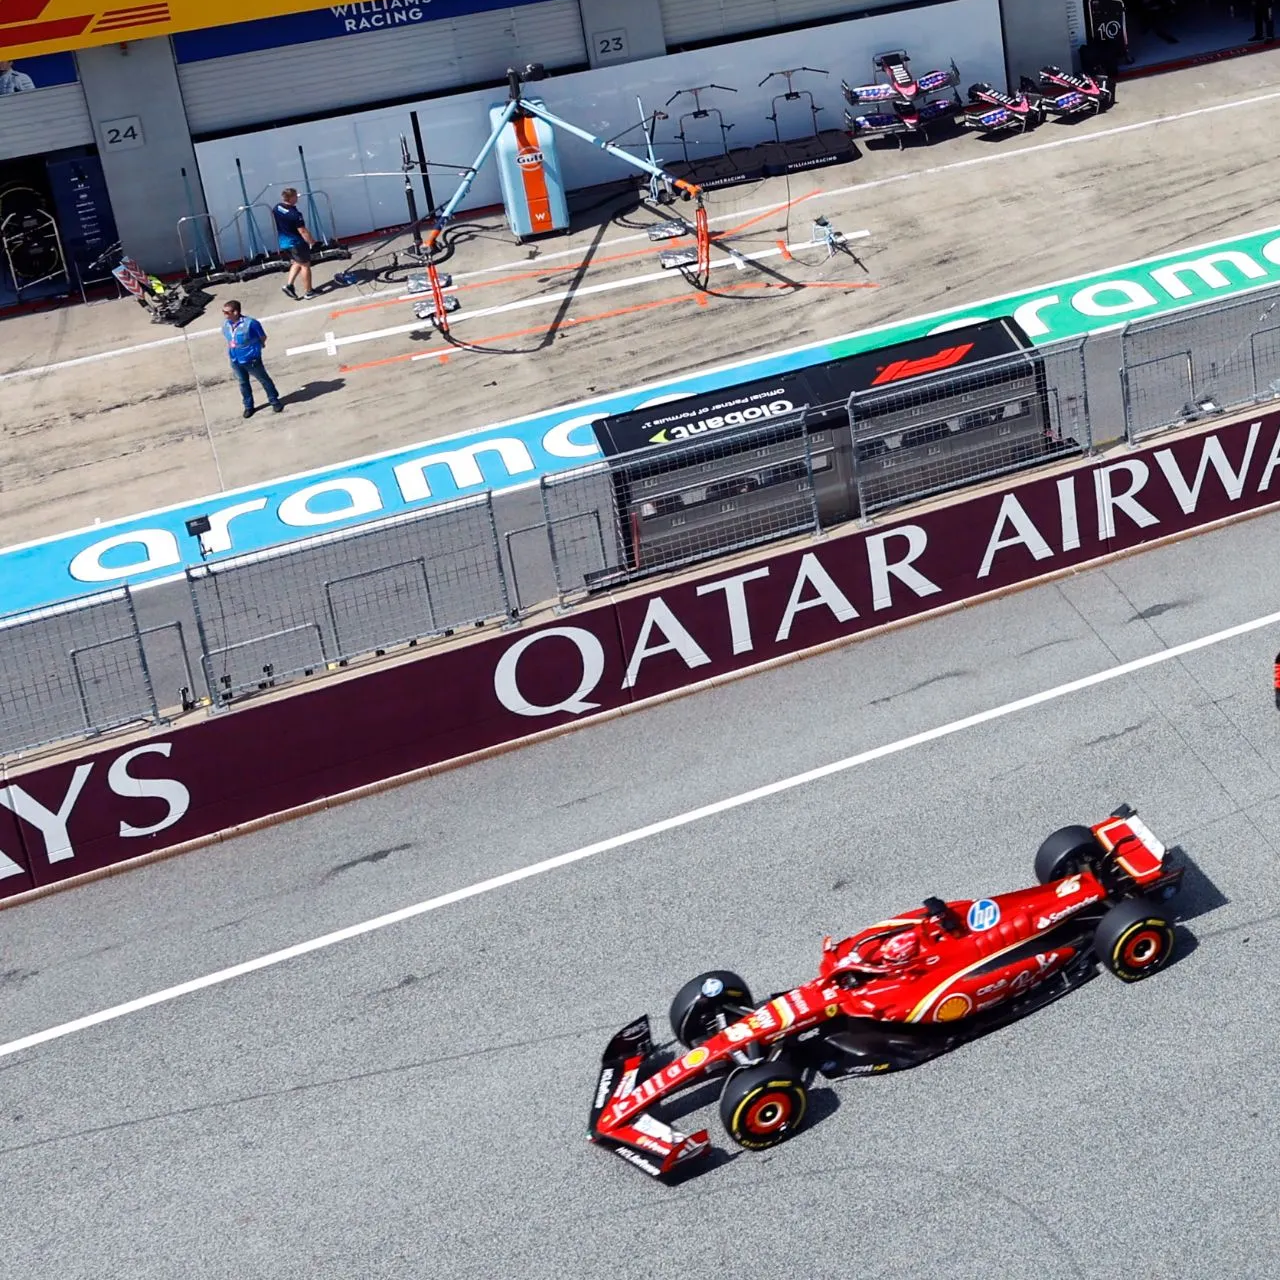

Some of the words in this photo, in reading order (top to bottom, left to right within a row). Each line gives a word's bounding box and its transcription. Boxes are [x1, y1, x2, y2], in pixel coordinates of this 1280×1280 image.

[344, 7, 424, 32] RACING
[600, 37, 624, 54] 23
[107, 125, 138, 144] 24
[517, 153, 543, 164] Gulf
[750, 388, 785, 402] Official
[698, 407, 710, 416] of
[712, 397, 749, 412] Partner
[653, 410, 697, 425] Formula
[670, 400, 793, 440] Globant
[494, 525, 942, 716] QATAR
[973, 900, 995, 928] hp
